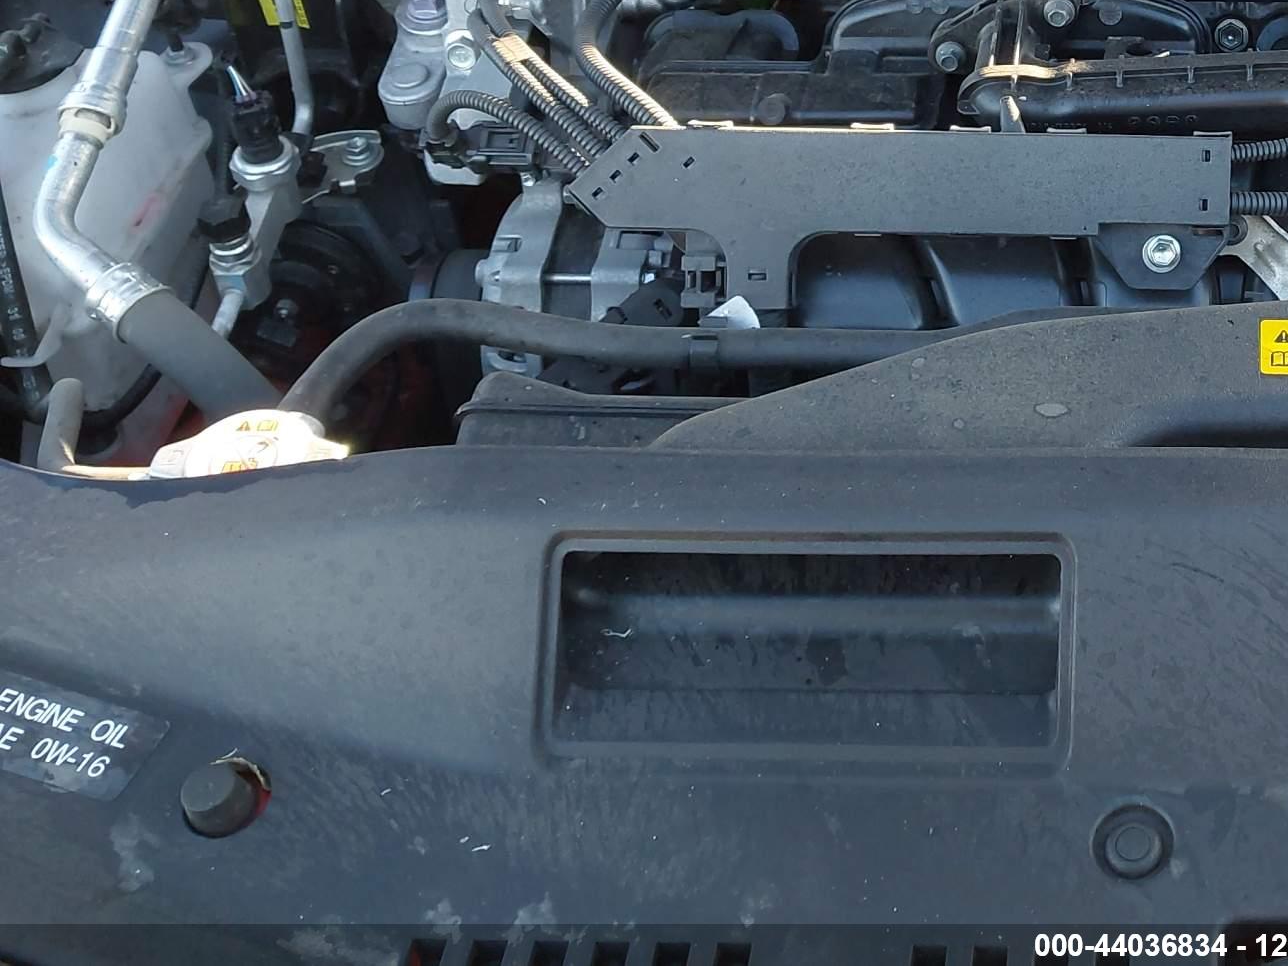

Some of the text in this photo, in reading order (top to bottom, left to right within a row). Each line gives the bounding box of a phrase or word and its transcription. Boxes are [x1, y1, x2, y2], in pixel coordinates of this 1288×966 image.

[0, 688, 129, 749] ENGINE OIL
[31, 737, 110, 777] 0W-16
